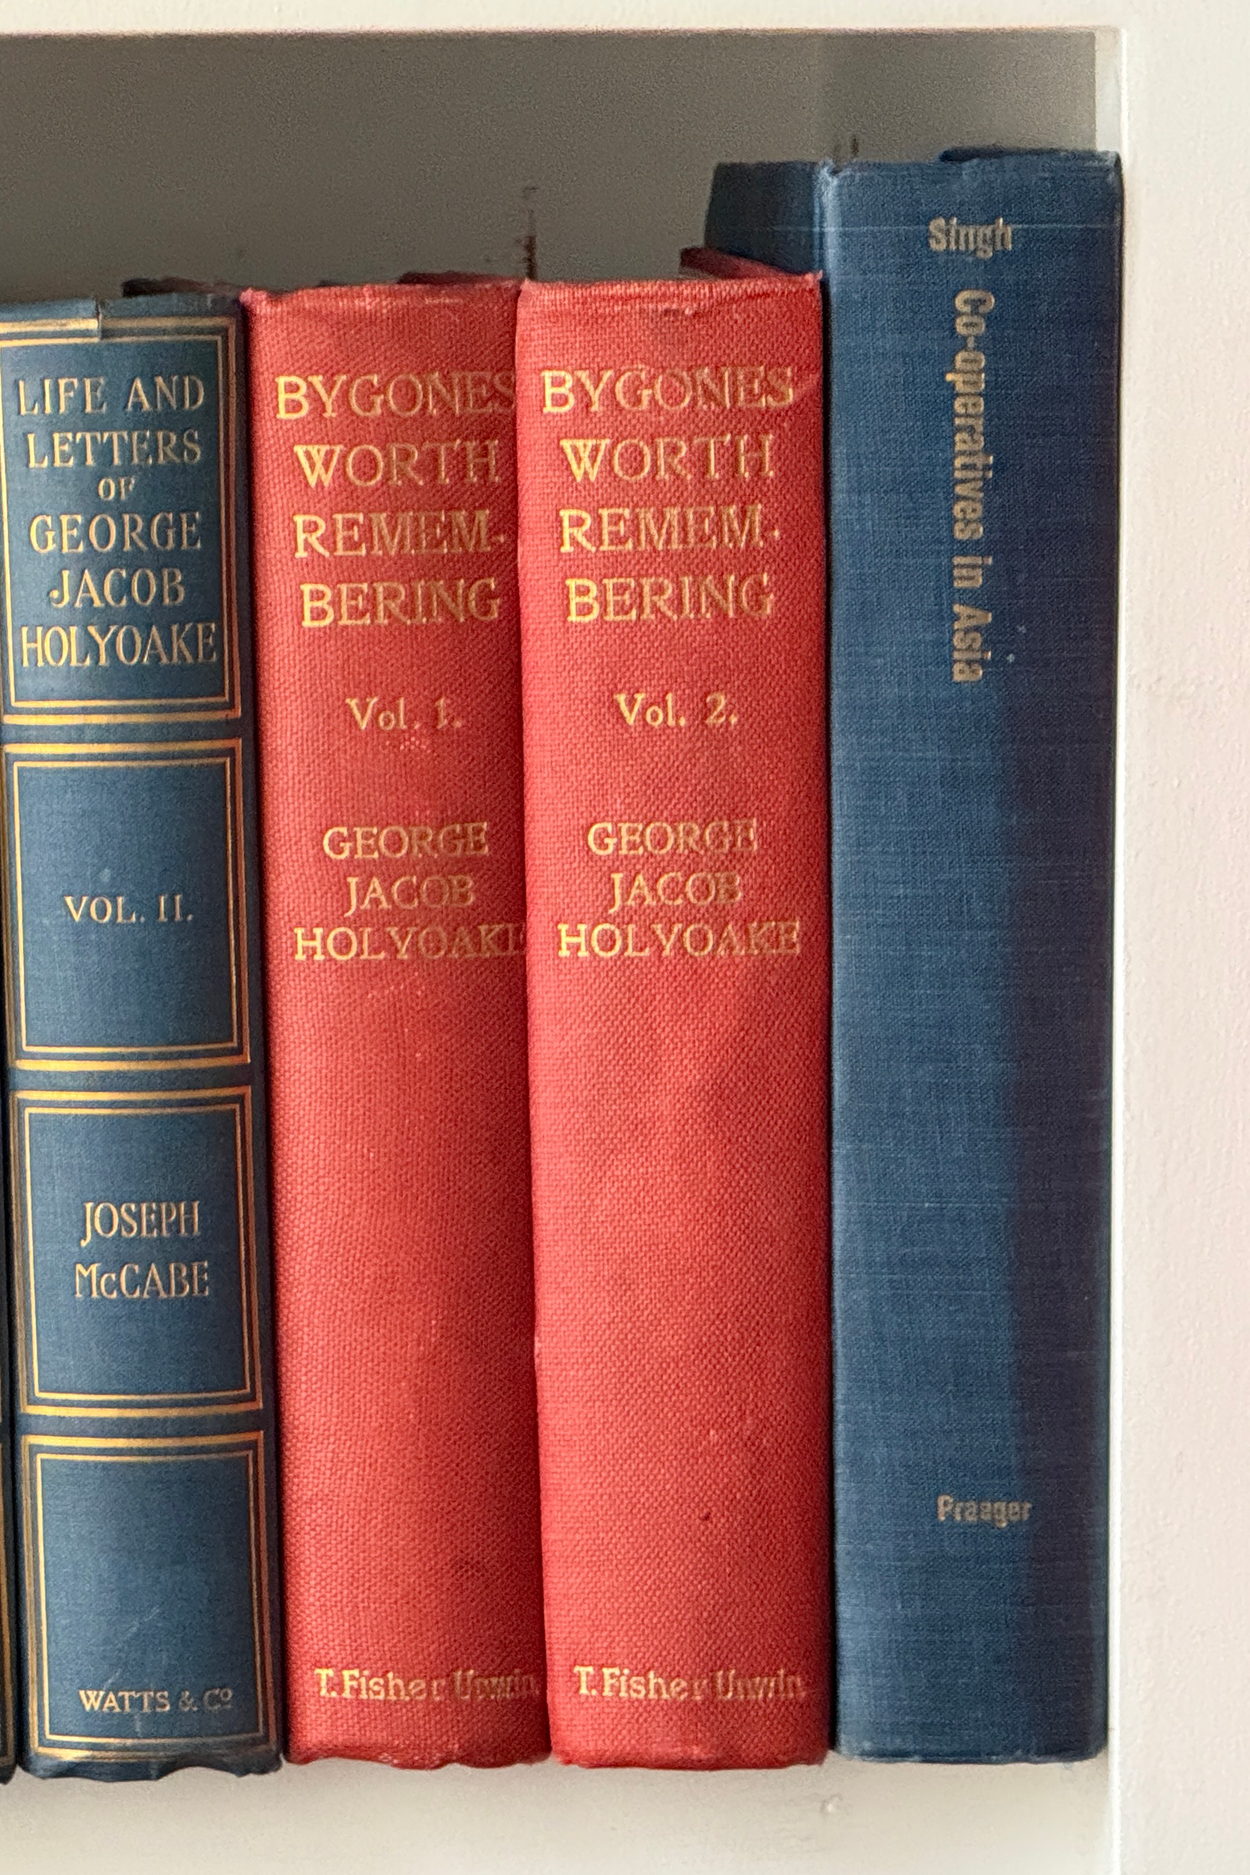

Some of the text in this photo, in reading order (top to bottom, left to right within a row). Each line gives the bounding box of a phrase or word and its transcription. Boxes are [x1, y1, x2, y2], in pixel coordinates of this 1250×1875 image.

[928, 216, 1012, 259] Singh
[18, 375, 205, 416] LIFE AND
[275, 370, 516, 420] BYGONES
[541, 364, 794, 414] BYGONES
[27, 428, 201, 469] LETTERS
[293, 438, 500, 488] WORTH
[560, 433, 774, 483] WORTH
[97, 475, 135, 501] OF
[945, 288, 995, 684] Co-operatives in Asia
[29, 511, 201, 554] GEORGE
[49, 567, 185, 609] JACOB
[300, 577, 501, 628] BERING
[565, 572, 774, 623] BERING
[21, 621, 217, 668] HOLYOAKE
[346, 697, 421, 730] Vol.
[614, 692, 738, 726] Vol. 2.
[323, 821, 489, 860] GEORGE
[587, 817, 758, 855] GEORGE
[64, 894, 193, 923] VOL. II.
[344, 874, 476, 918] JACOB
[608, 871, 742, 914] JACOB
[557, 918, 800, 958] HOLYOAKE
[80, 1200, 201, 1247] JOSEPH
[74, 1260, 210, 1299] McCABE
[937, 1493, 1033, 1528] Praeger
[78, 1689, 170, 1713] WATTS
[178, 1690, 198, 1712] &
